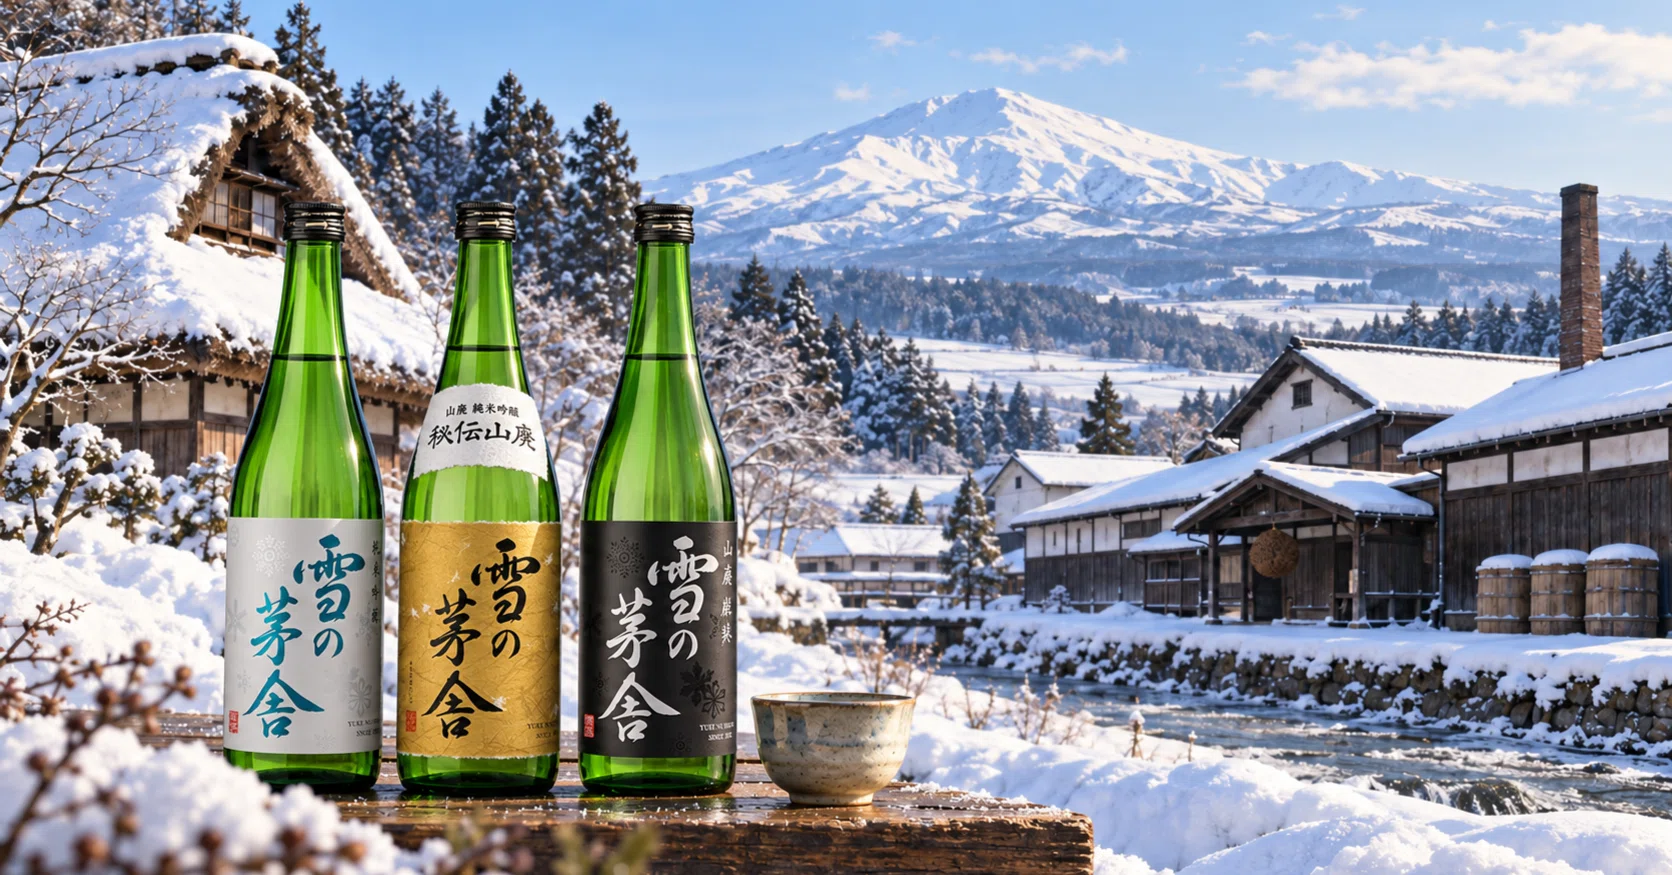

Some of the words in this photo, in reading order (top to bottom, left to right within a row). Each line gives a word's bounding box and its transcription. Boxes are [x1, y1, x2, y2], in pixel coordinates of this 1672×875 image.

[427, 420, 537, 452] 秘伝山廃
[293, 533, 366, 659] 雪の
[471, 537, 541, 660] 雪の
[647, 535, 720, 661] 雪の
[242, 585, 326, 739] 茅舎
[421, 587, 504, 740] 茅舎
[597, 586, 682, 743] 茅舎
